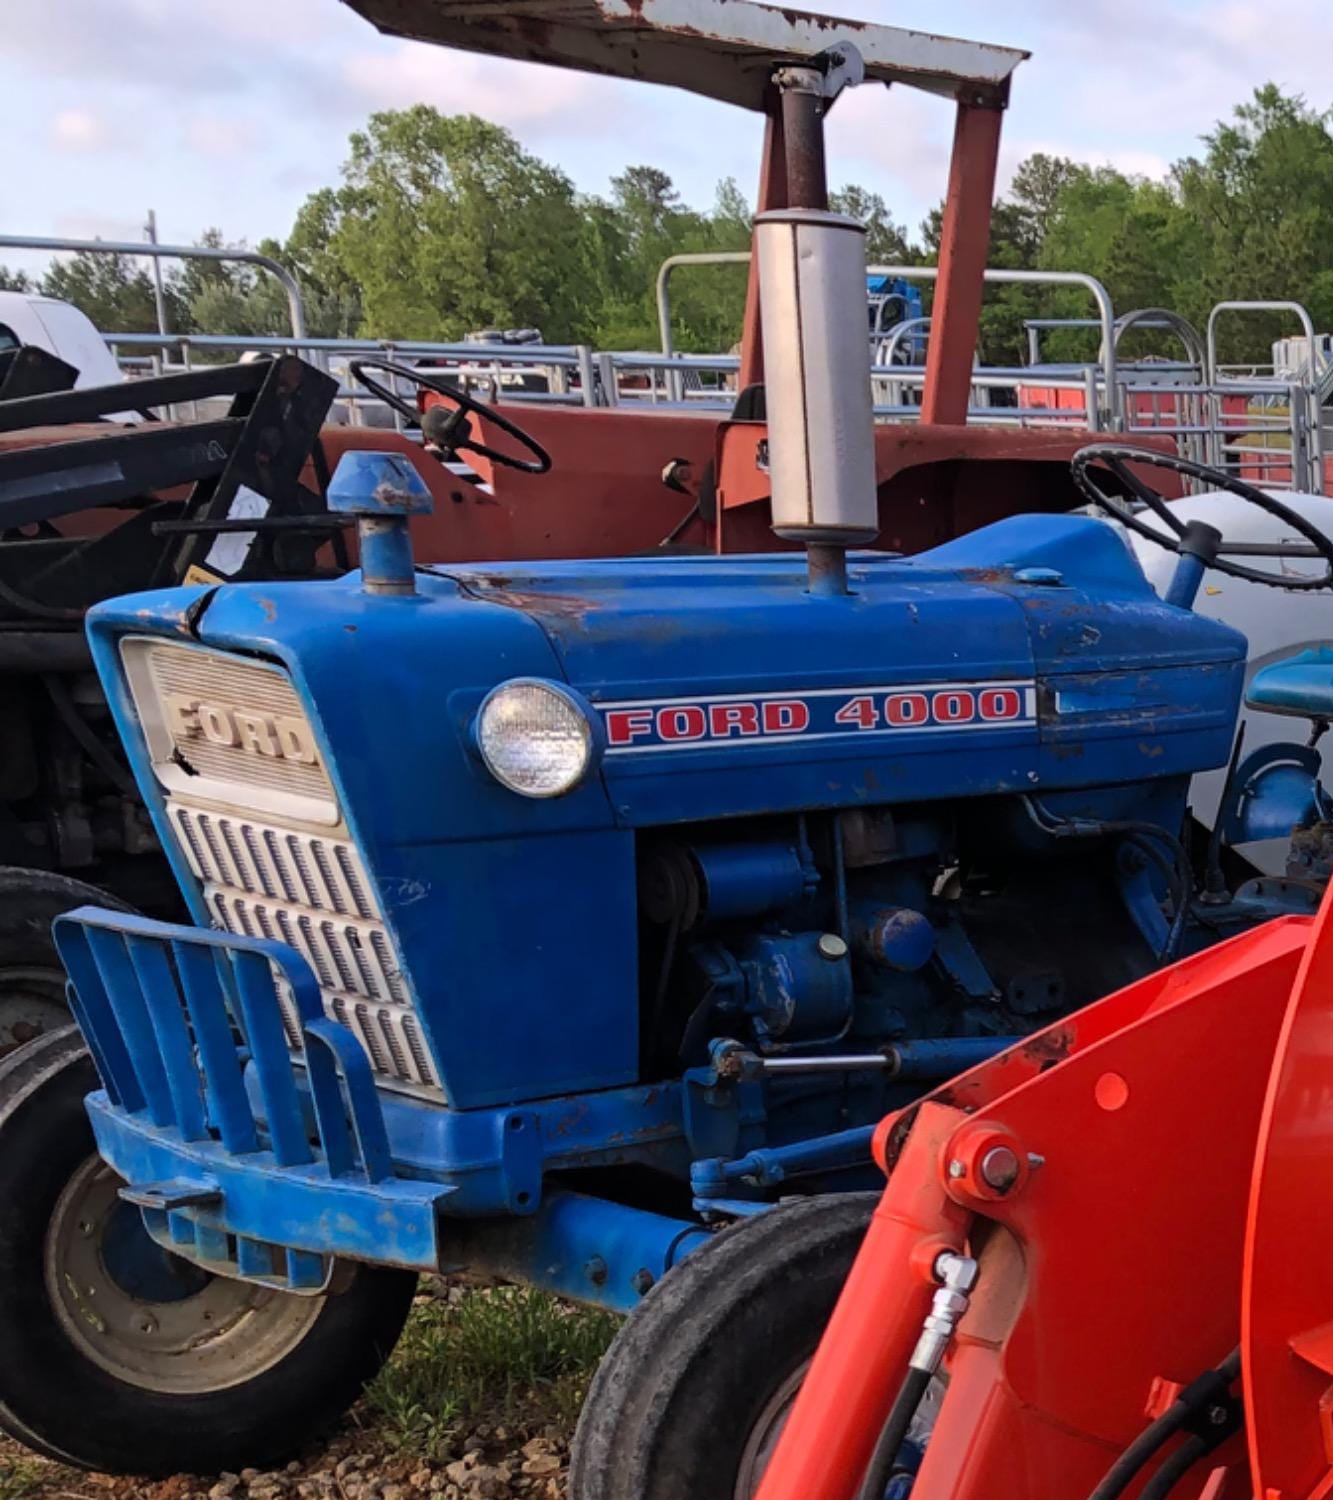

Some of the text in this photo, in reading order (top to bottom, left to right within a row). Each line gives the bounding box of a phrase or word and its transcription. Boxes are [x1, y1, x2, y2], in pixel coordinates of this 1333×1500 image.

[164, 694, 316, 763] FORD
[606, 688, 1021, 745] FORD 4000
